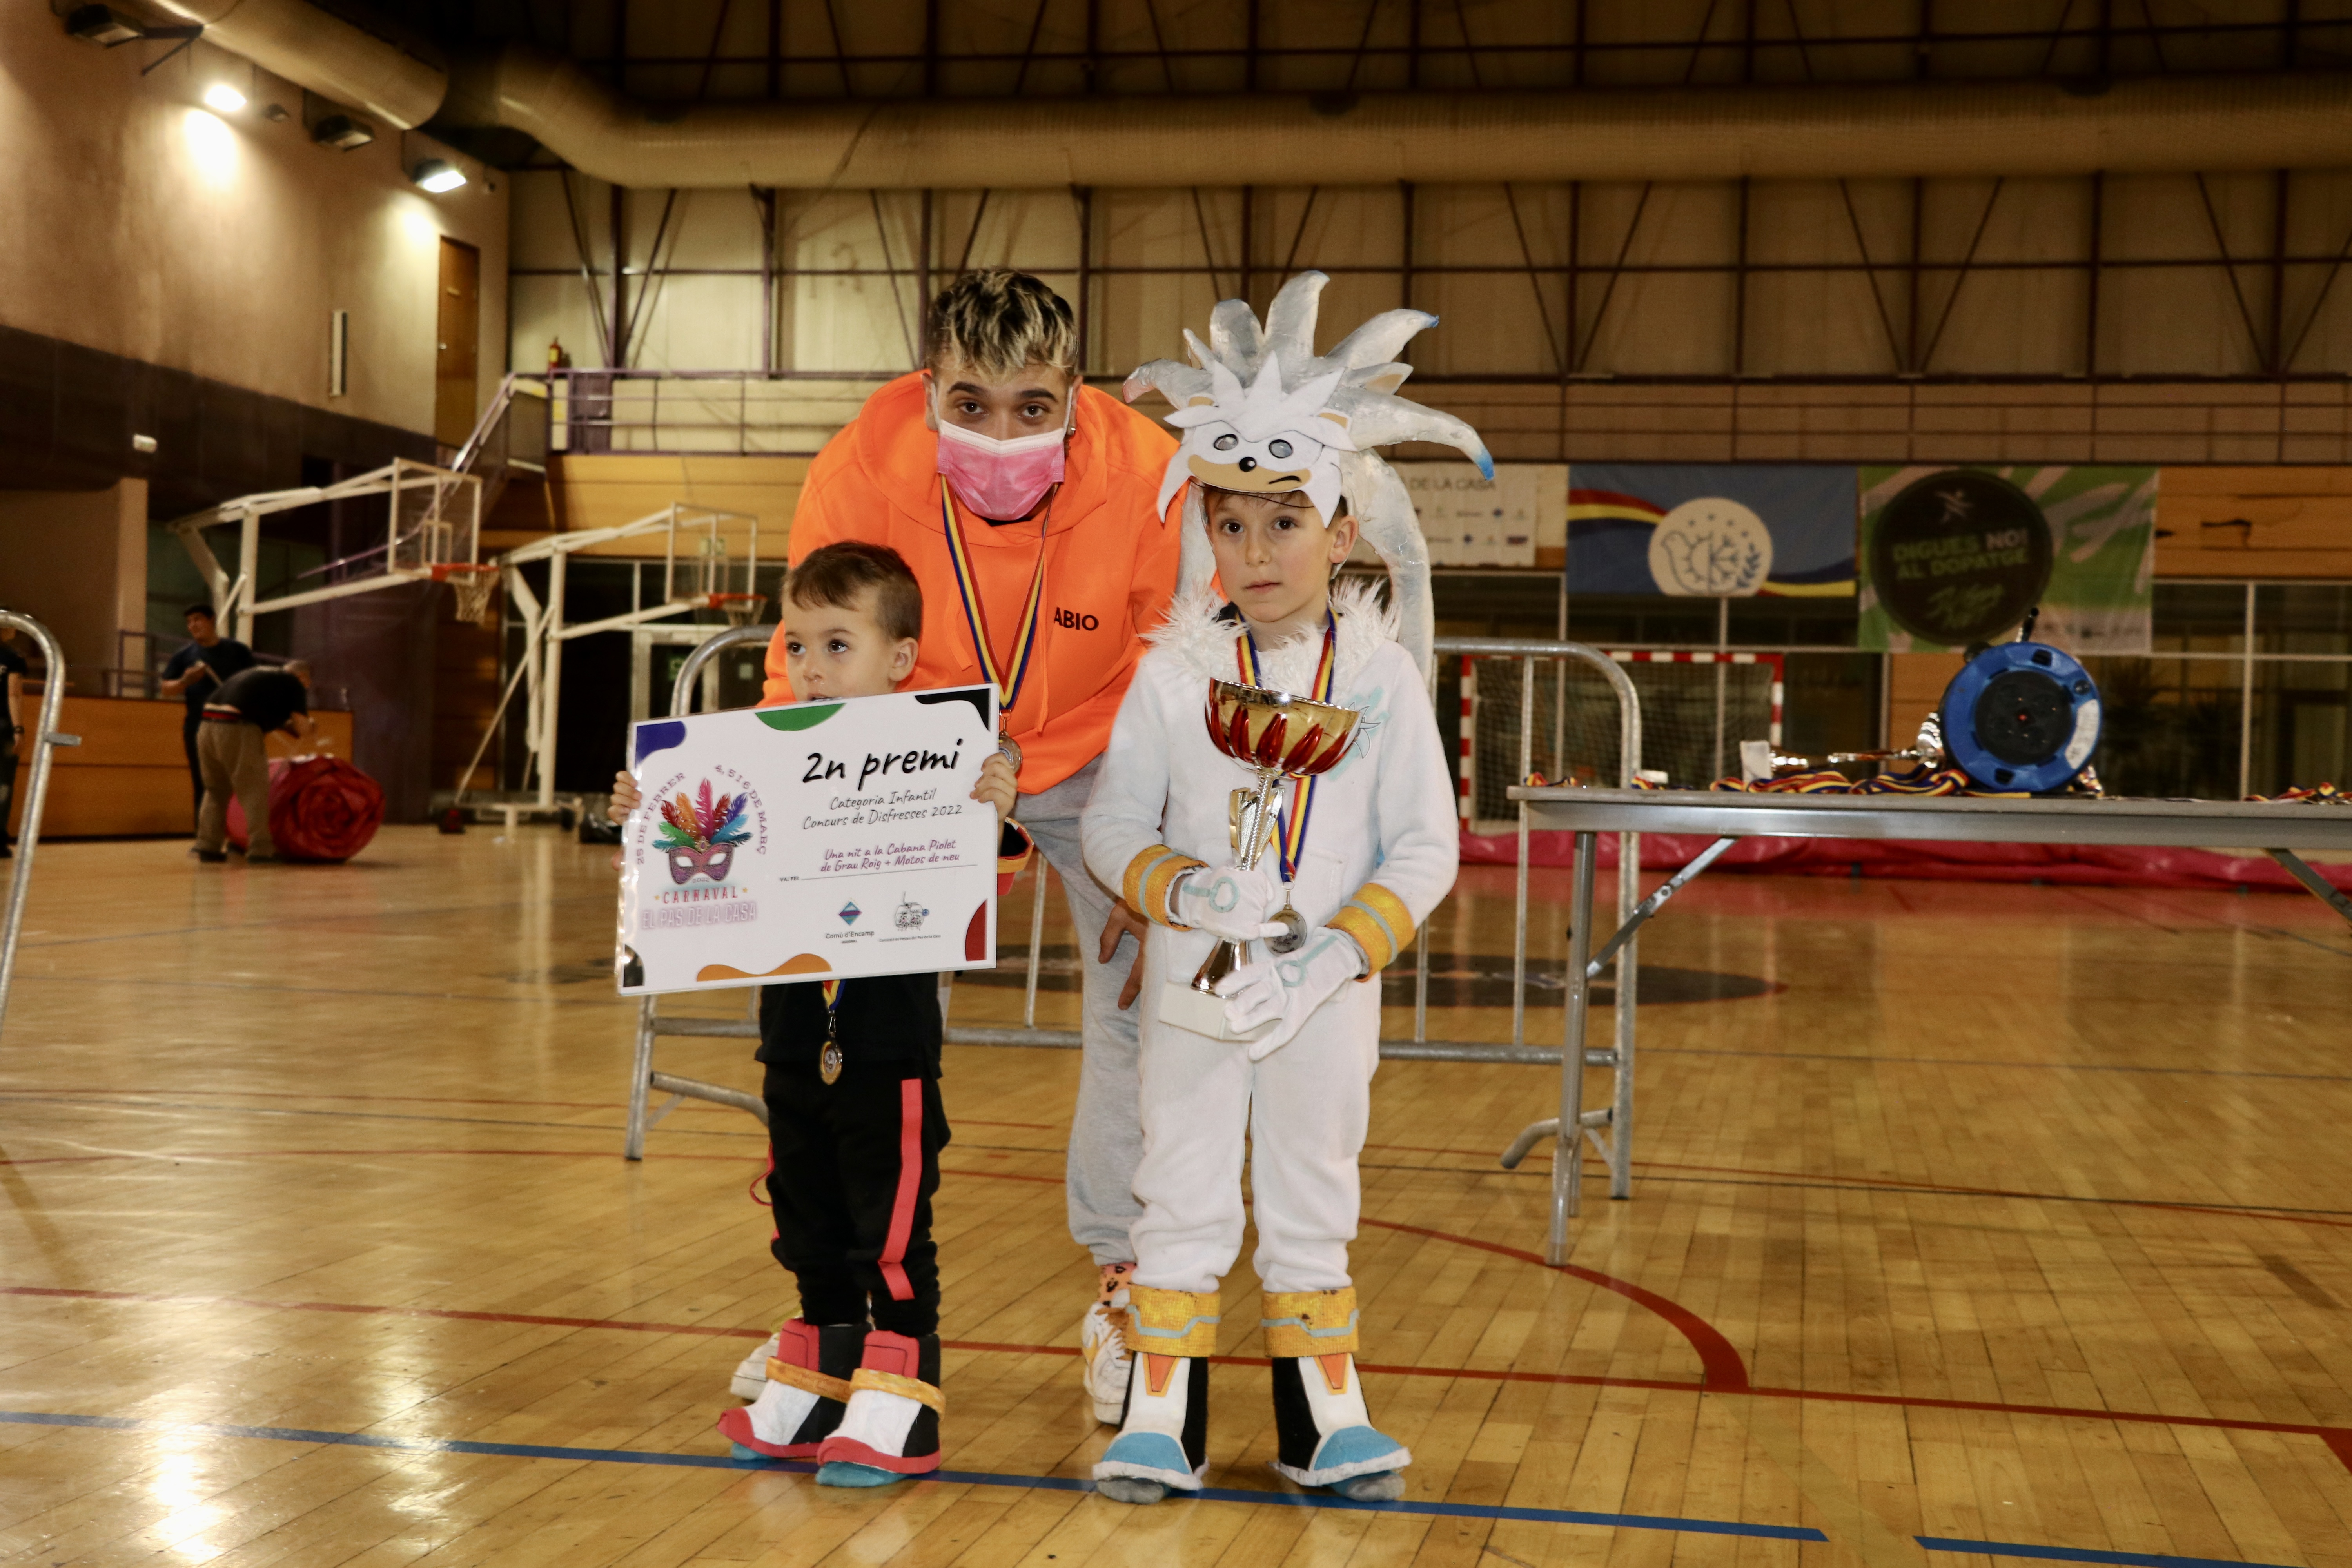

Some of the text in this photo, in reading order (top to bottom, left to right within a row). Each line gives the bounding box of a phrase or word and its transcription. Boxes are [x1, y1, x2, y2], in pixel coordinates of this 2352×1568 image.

[1986, 528, 2028, 550] NO!
[802, 738, 964, 791] 2n premi
[830, 788, 937, 810] Categoria Infantil
[637, 772, 685, 864] 25 DE FEBRER
[749, 789, 762, 808] DE
[757, 811, 768, 855] MARÇ
[803, 805, 962, 830] Concurs de Disfresses 2022
[825, 849, 844, 860] Una
[848, 849, 861, 857] nit
[874, 845, 883, 855] la
[887, 842, 926, 855] Cabana
[929, 839, 956, 851] Piolet
[820, 862, 831, 872] de
[835, 860, 858, 872] Grau
[861, 858, 882, 870] Roig
[895, 855, 926, 866] Motos
[929, 853, 940, 862] de
[663, 886, 738, 904] CARNAVAL
[642, 902, 757, 929] EL PAS DE LA CASA
